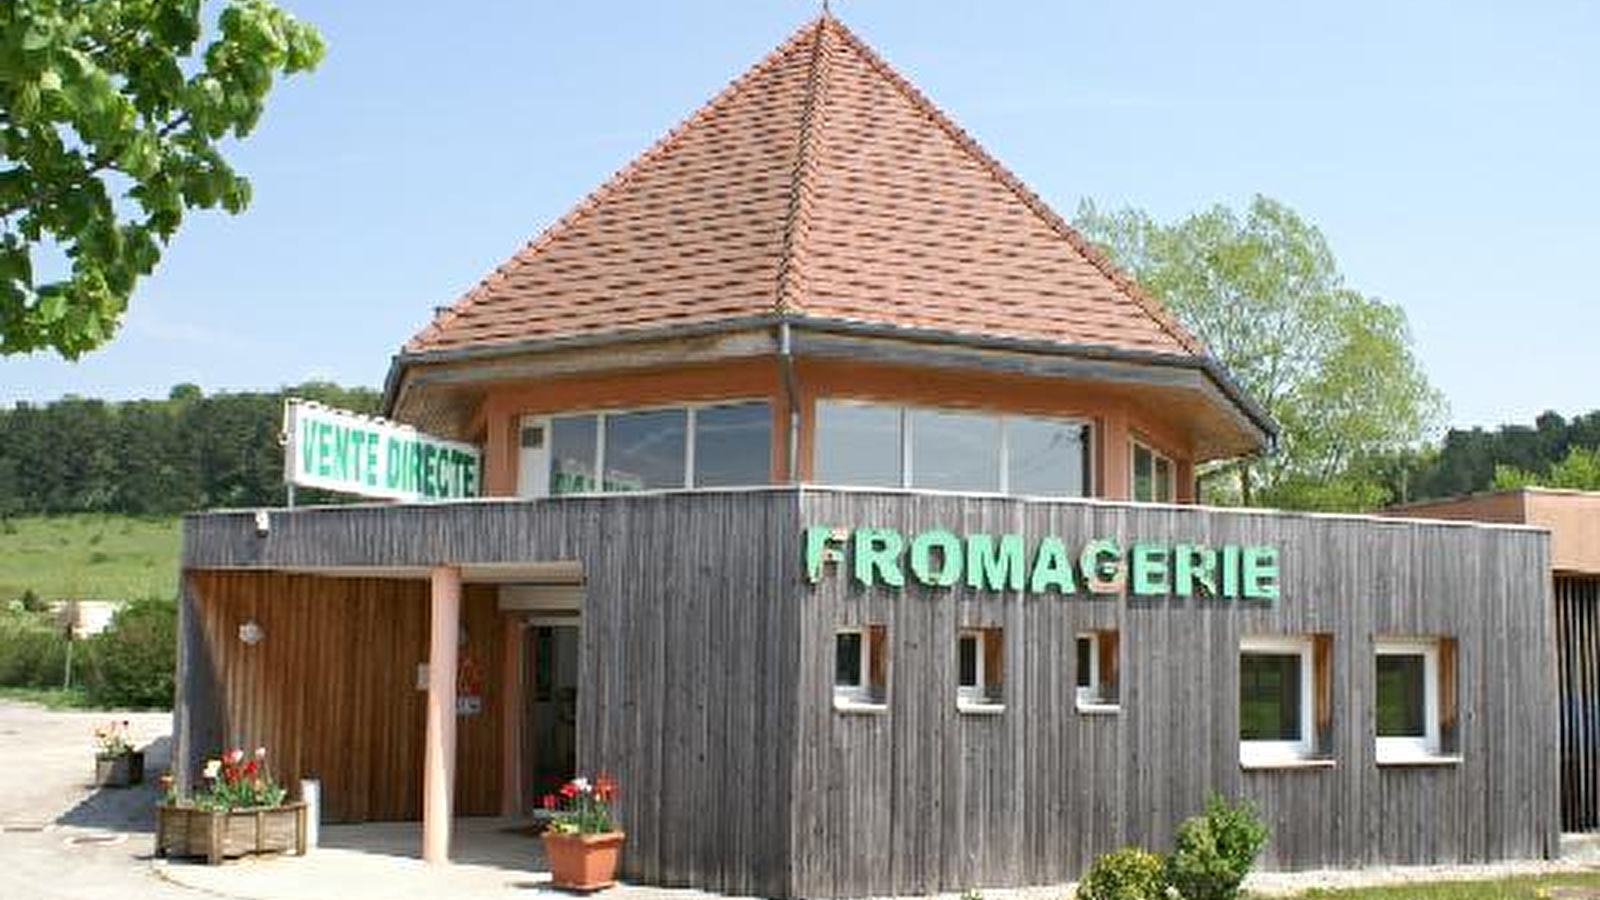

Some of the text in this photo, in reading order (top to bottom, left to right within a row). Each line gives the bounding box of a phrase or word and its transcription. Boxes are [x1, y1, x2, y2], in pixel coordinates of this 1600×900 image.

[303, 418, 476, 499] VENTE DIRECTE
[805, 525, 1281, 600] FROMAGERIE
